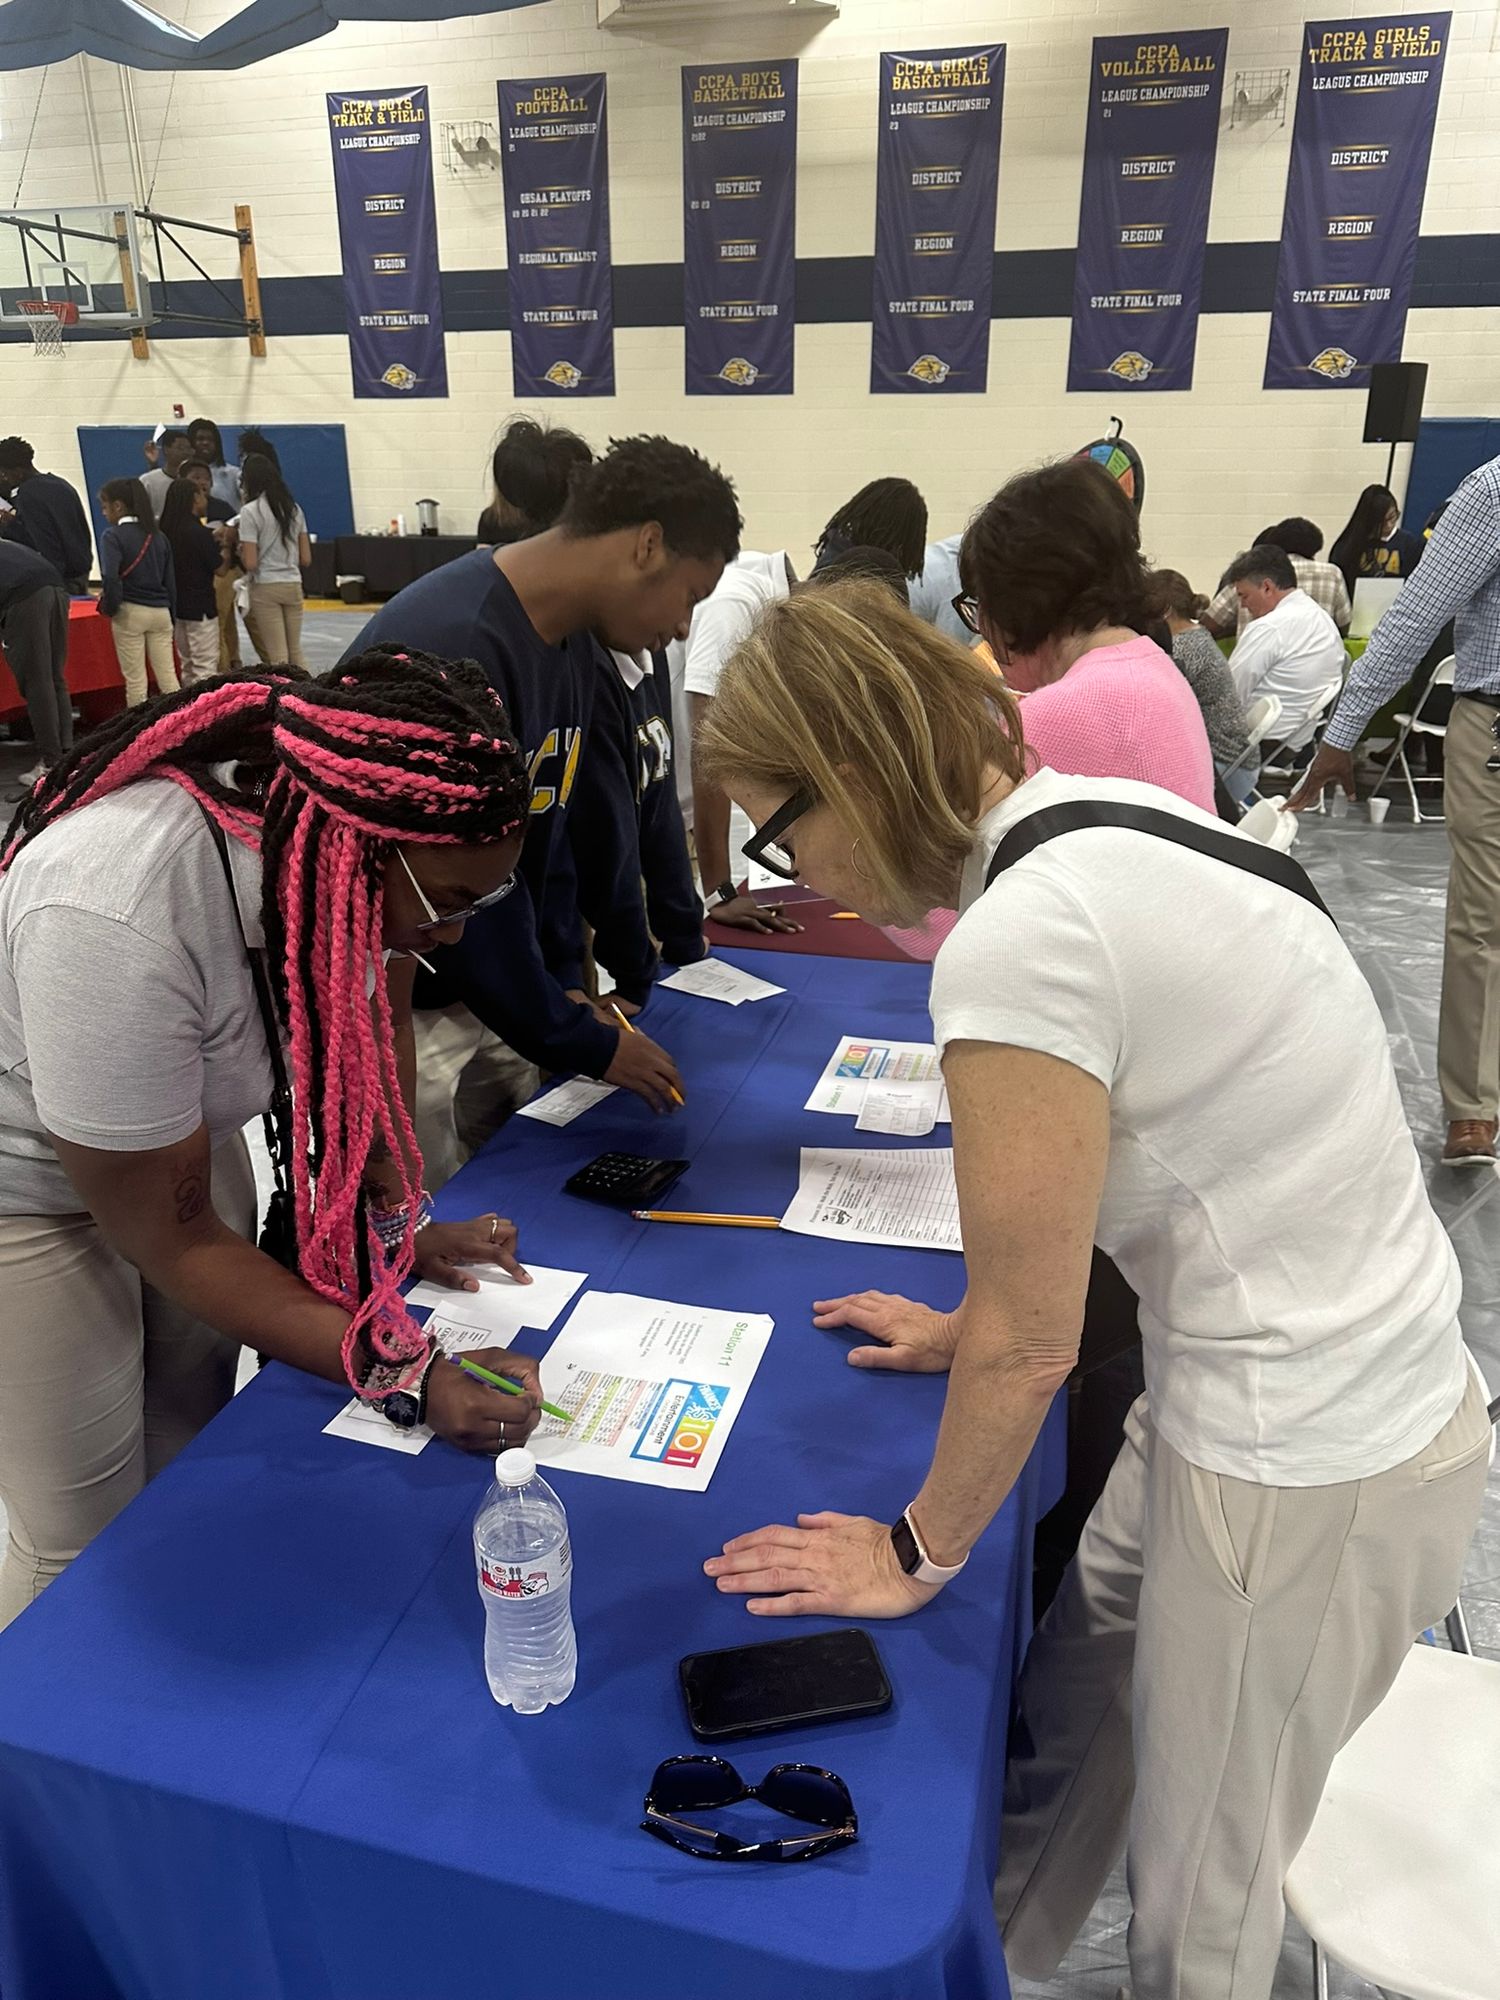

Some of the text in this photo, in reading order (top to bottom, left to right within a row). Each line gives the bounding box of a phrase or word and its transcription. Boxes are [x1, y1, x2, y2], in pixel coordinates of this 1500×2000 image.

[1322, 25, 1430, 47] CCPA GIRLS
[1137, 44, 1179, 60] CCPA
[1309, 40, 1441, 64] TRACK & FIELD
[896, 56, 988, 76] CCPA GIRLS
[1101, 56, 1215, 77] VOLLEYBALL
[699, 71, 780, 89] CCPA BOYS
[892, 71, 990, 90] BASKETBALL
[1312, 70, 1429, 90] LEAGUE CHAMPIONSHIP
[534, 86, 568, 100] CCPA
[694, 85, 785, 103] BASKETBALL
[1102, 84, 1210, 102] LEAGUE CHAMPIONSHIP
[342, 96, 412, 114] CCPA BOYS
[516, 98, 588, 115] FOOTBALL
[890, 98, 990, 115] LEAGUE CHAMPIONSHIP
[332, 108, 425, 127] TRACK & FIELD
[693, 110, 786, 127] LEAGUE CHAMPIONSHIP
[509, 123, 597, 139] LEAGUE CHAMPIONSHIP
[889, 121, 899, 130] 23
[340, 134, 421, 150] LEAGUE CHAMPIONSHIP
[1331, 151, 1389, 165] DISTRICT
[1121, 161, 1176, 175] DISTRICT
[912, 171, 962, 185] DISTRICT
[715, 181, 762, 194] DISTRICT
[520, 190, 591, 204] OHSAA PLAYOFFS
[364, 199, 405, 212] DISTRICT
[540, 208, 549, 216] 22
[1328, 221, 1373, 234] REGION
[1121, 229, 1163, 242] REGION
[721, 245, 757, 256] REGION
[914, 238, 954, 250] REGION
[374, 258, 406, 270] REGION
[519, 251, 597, 264] REGIONAL FINALIST
[1090, 294, 1182, 308] STATE FINAL FOUR
[1293, 288, 1391, 302] STATE FINAL FOUR
[700, 305, 778, 317] STATE FINAL FOUR
[889, 300, 974, 312] STATE FINAL FOUR
[360, 314, 430, 326] STATE FINAL FOUR
[523, 310, 598, 322] STATE FINAL FOUR
[718, 1322, 748, 1367] Station 11
[654, 1394, 685, 1445] Entertainment
[667, 1423, 710, 1464] 101
